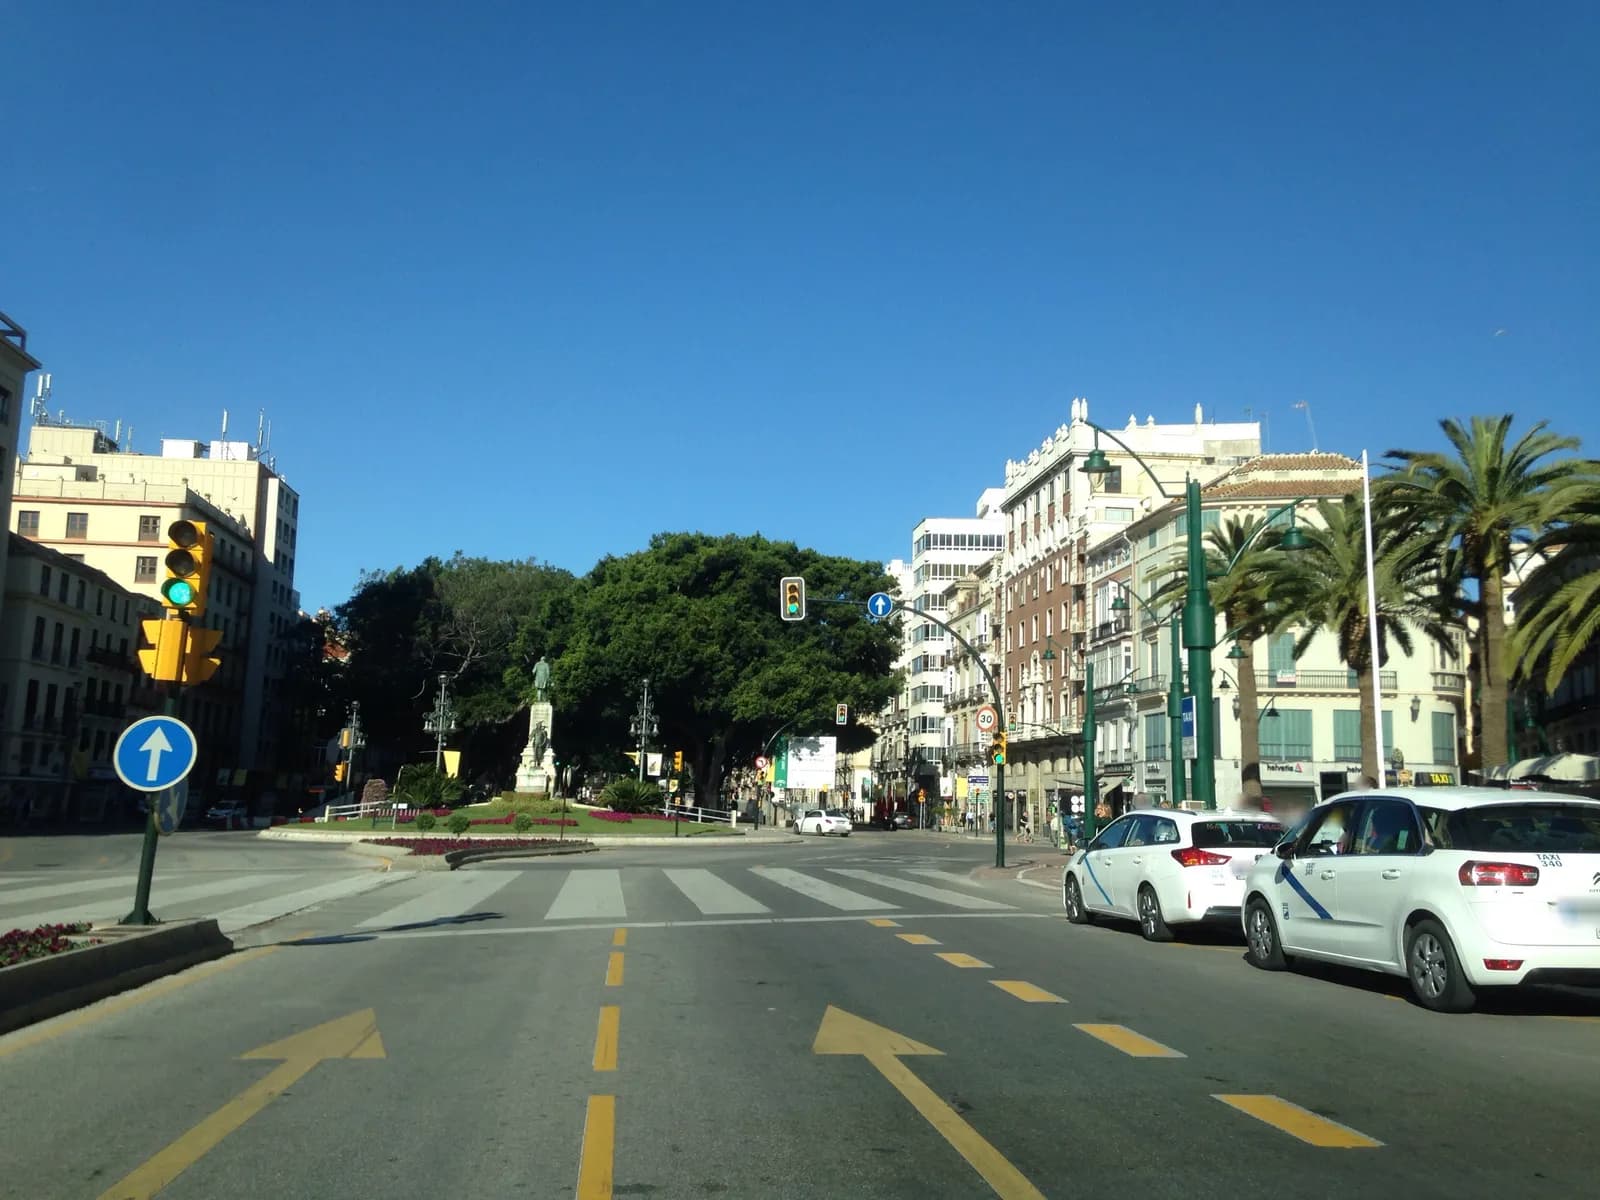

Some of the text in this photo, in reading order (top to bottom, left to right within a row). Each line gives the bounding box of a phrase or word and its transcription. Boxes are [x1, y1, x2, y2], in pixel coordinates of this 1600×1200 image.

[980, 714, 992, 723] 30
[1182, 712, 1193, 722] TAXI
[1267, 763, 1293, 772] helvetia
[1431, 774, 1449, 784] TAXI
